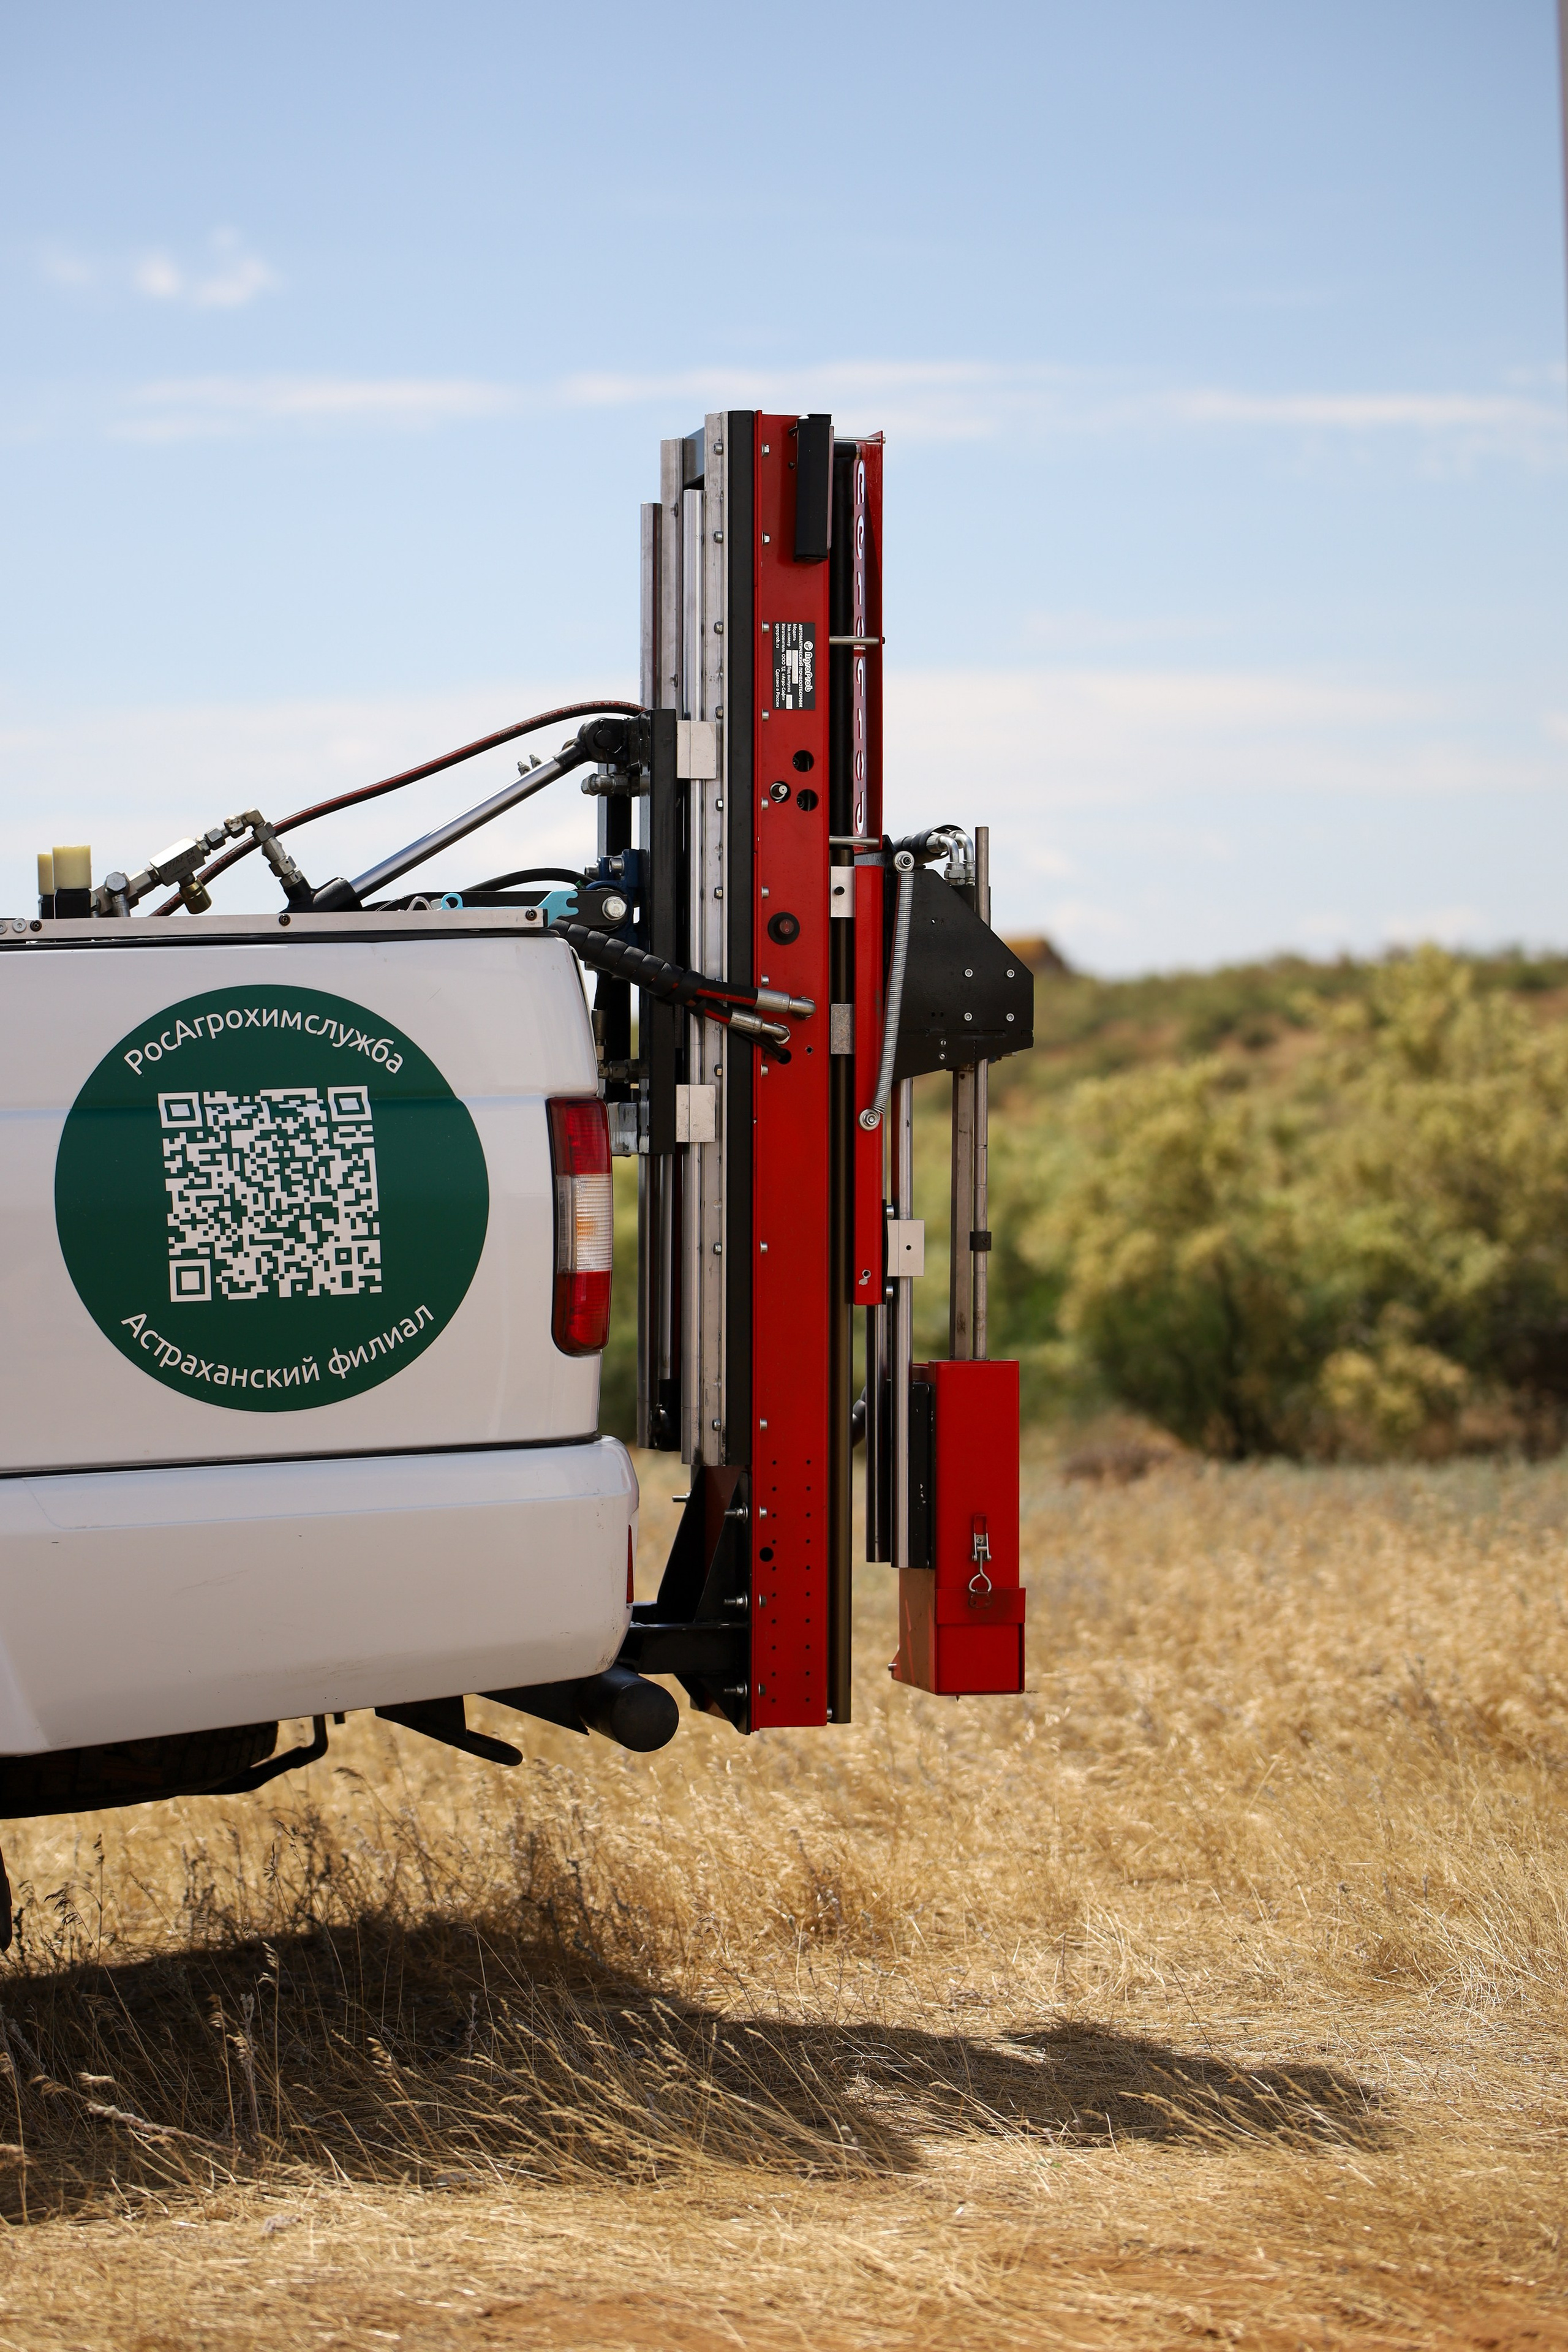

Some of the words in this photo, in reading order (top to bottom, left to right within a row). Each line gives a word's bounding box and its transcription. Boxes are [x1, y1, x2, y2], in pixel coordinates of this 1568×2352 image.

[803, 652, 813, 692] AgroProb
[123, 1008, 404, 1076] РосАгрохимслужба
[121, 1312, 320, 1389] Астраханский
[327, 1304, 435, 1380] филиал
